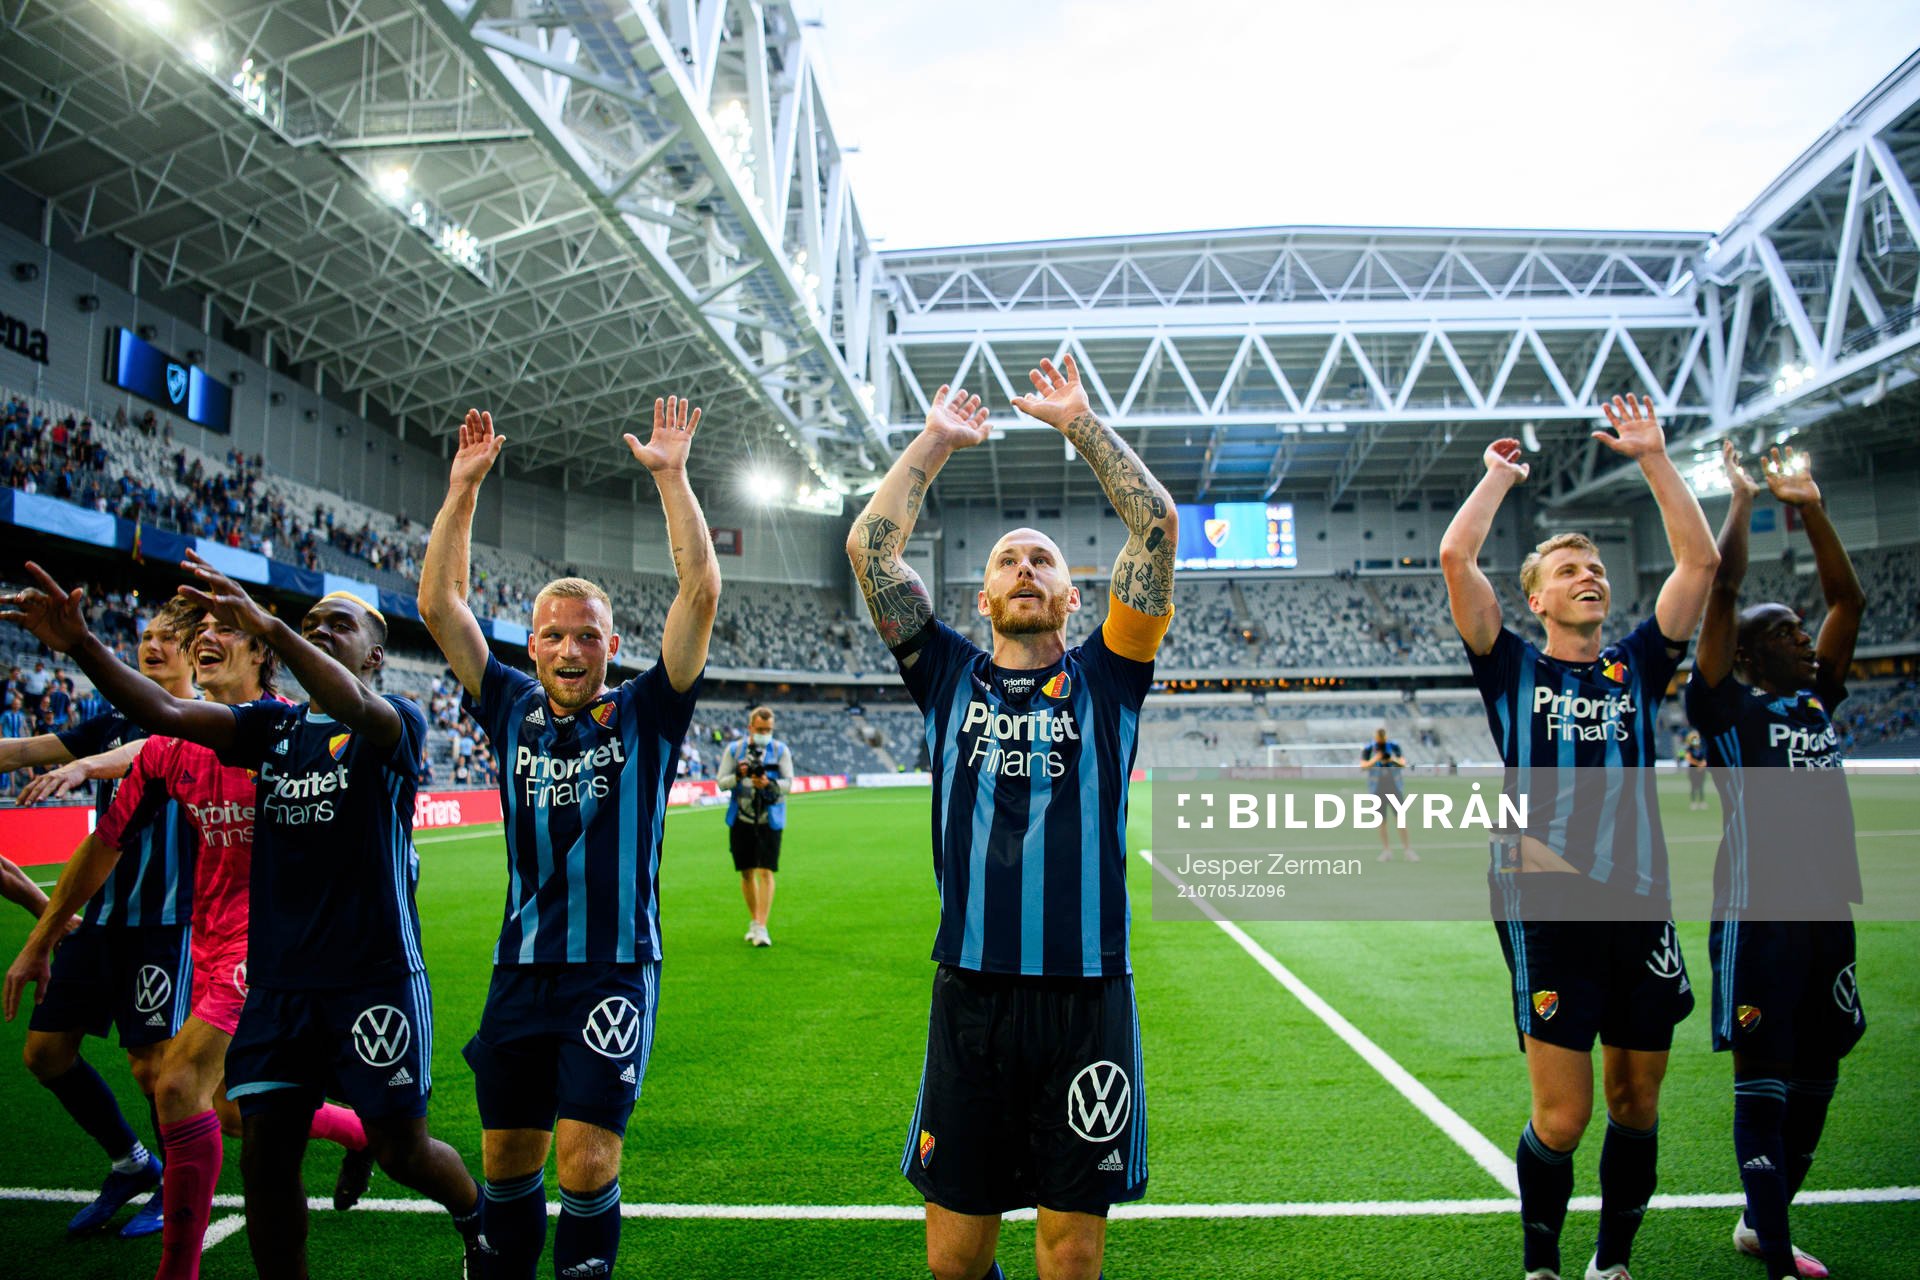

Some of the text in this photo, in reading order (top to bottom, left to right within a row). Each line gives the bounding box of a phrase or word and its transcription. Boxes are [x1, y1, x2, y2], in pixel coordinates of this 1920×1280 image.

[1547, 714, 1629, 741] Finans
[967, 736, 1065, 778] Finans
[526, 775, 610, 808] Finans
[1098, 1162, 1124, 1171] adidas
